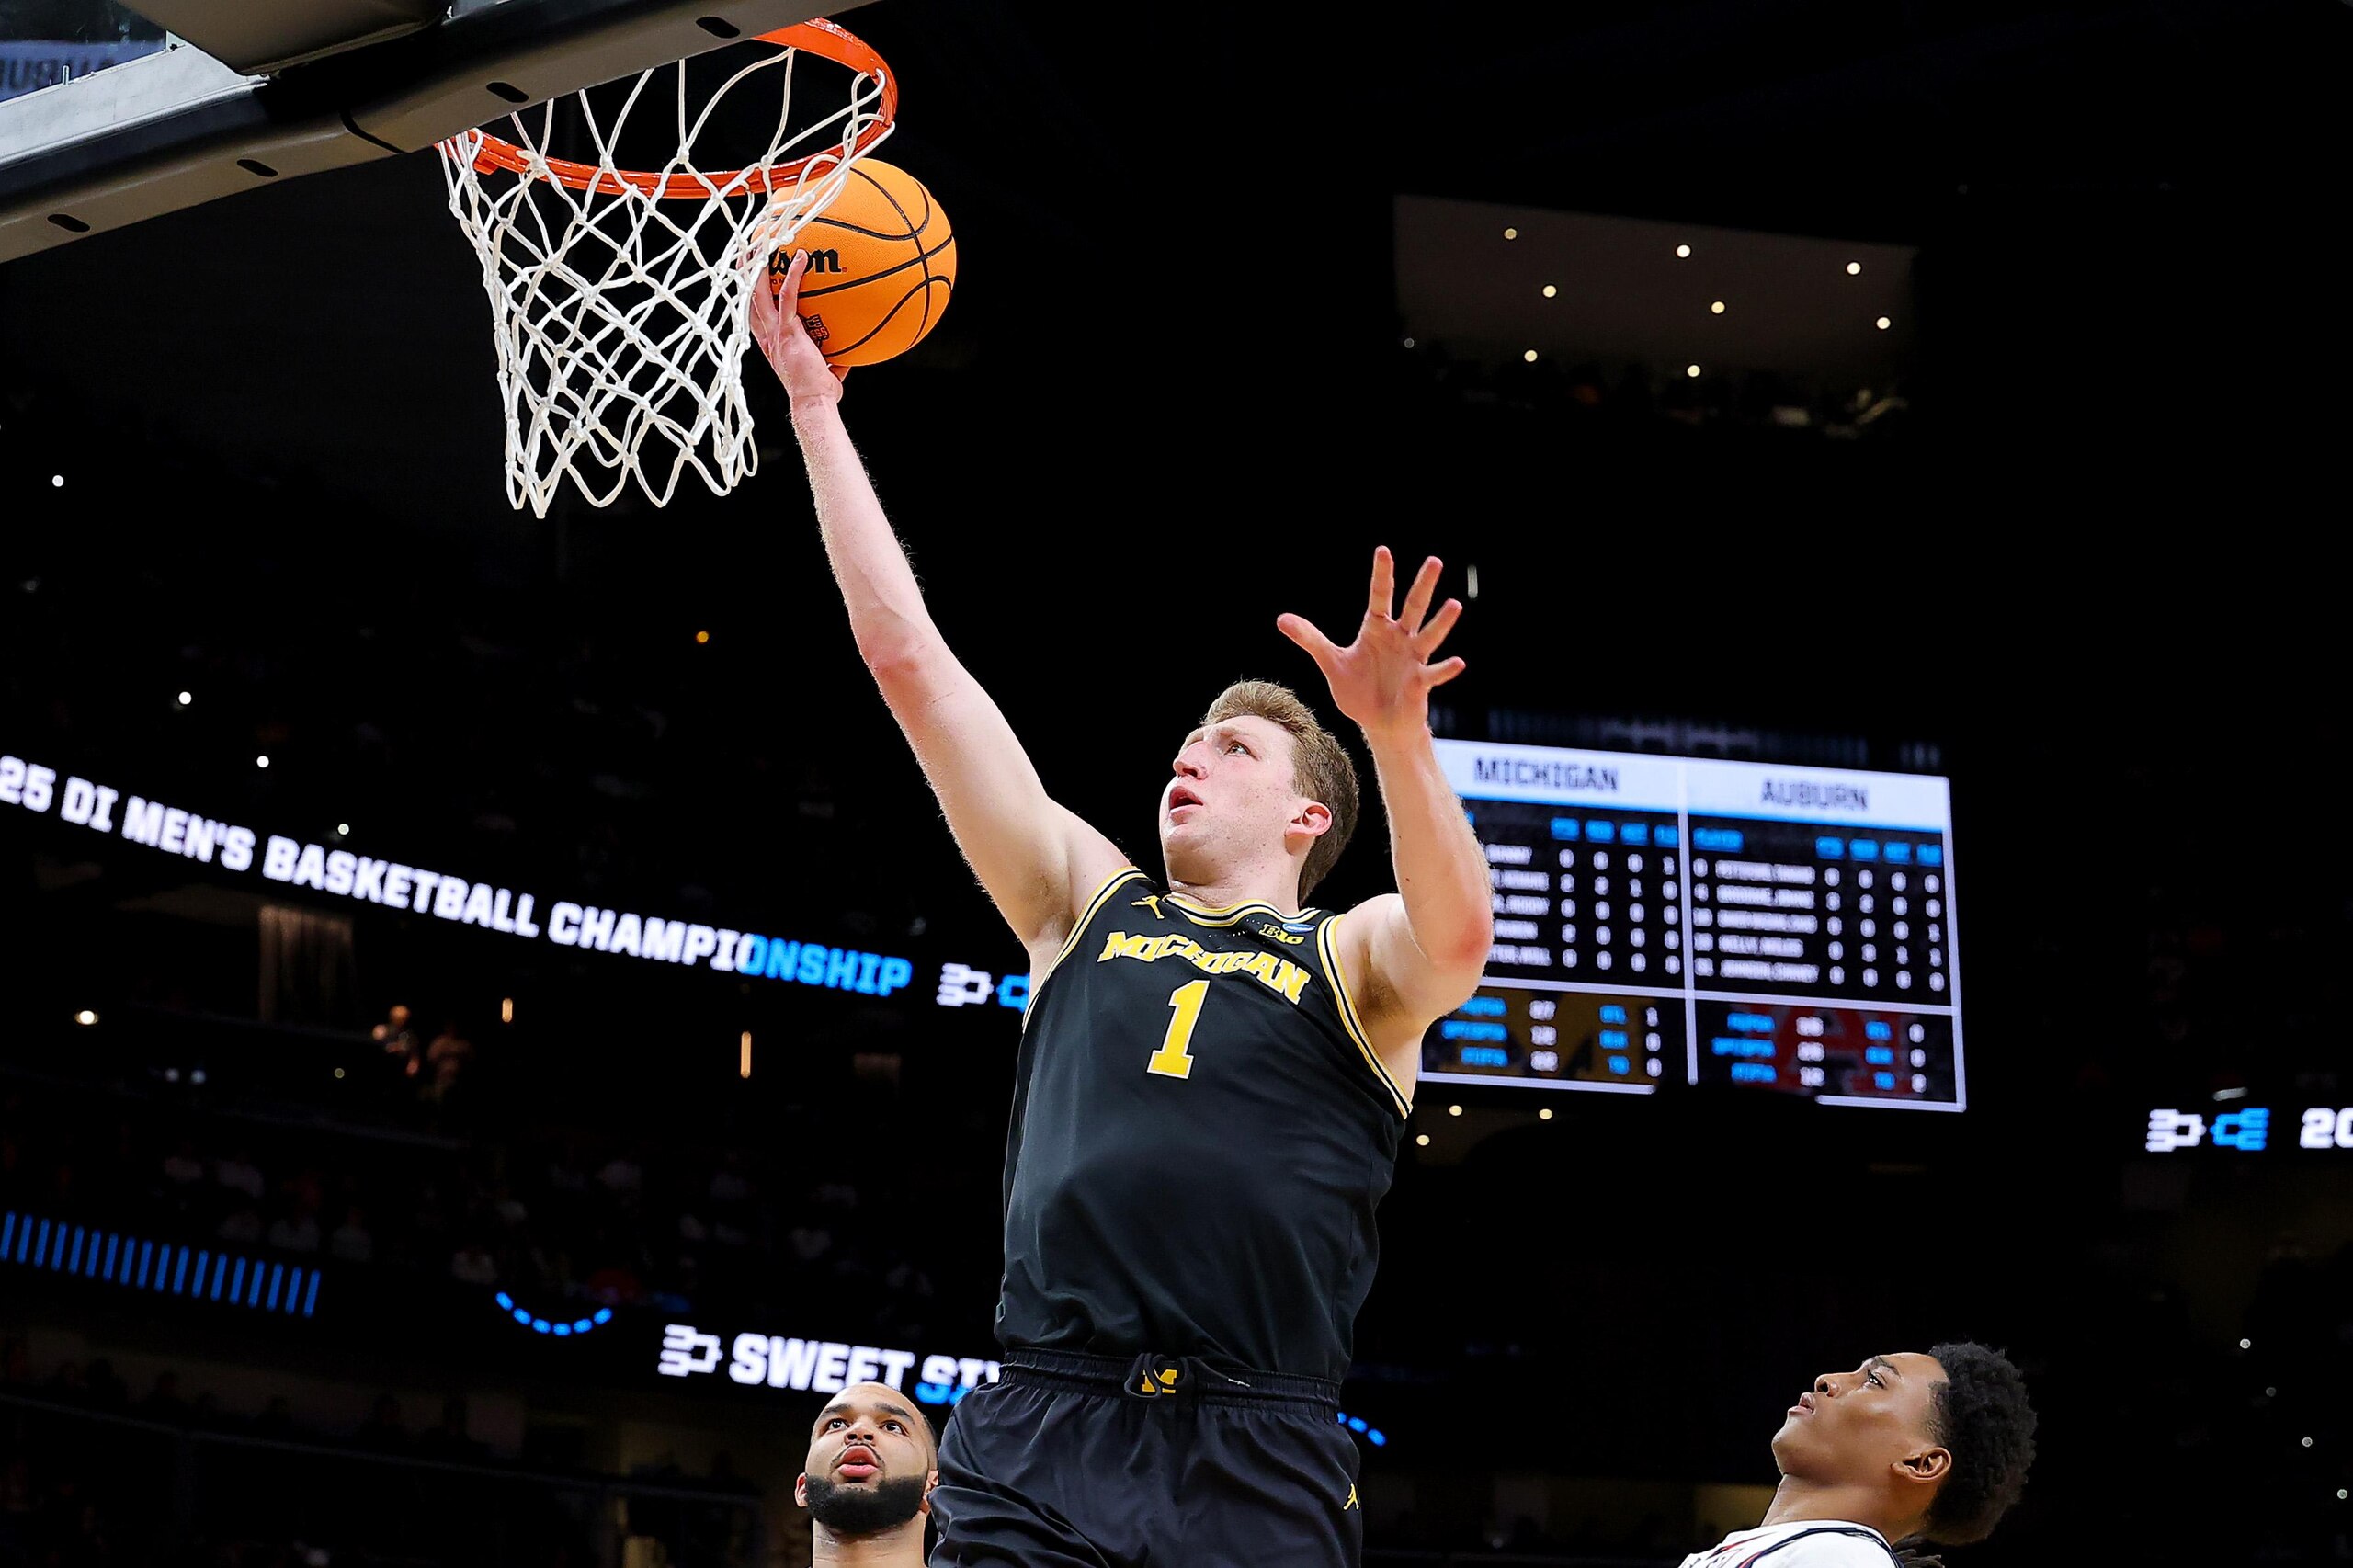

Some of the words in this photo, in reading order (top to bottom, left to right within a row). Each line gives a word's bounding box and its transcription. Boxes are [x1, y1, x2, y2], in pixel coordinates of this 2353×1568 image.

[1474, 758, 1619, 792] MICHIGAN
[1761, 779, 1869, 812] AUBURN
[61, 776, 119, 833] DI
[121, 796, 256, 871] MEN'S
[263, 835, 540, 938] BASKETBALL
[548, 901, 913, 997] CHAMPIONSHIP
[1097, 931, 1312, 1006] MICHIGAN
[1146, 979, 1211, 1080] 1
[729, 1332, 915, 1394] SWEET
